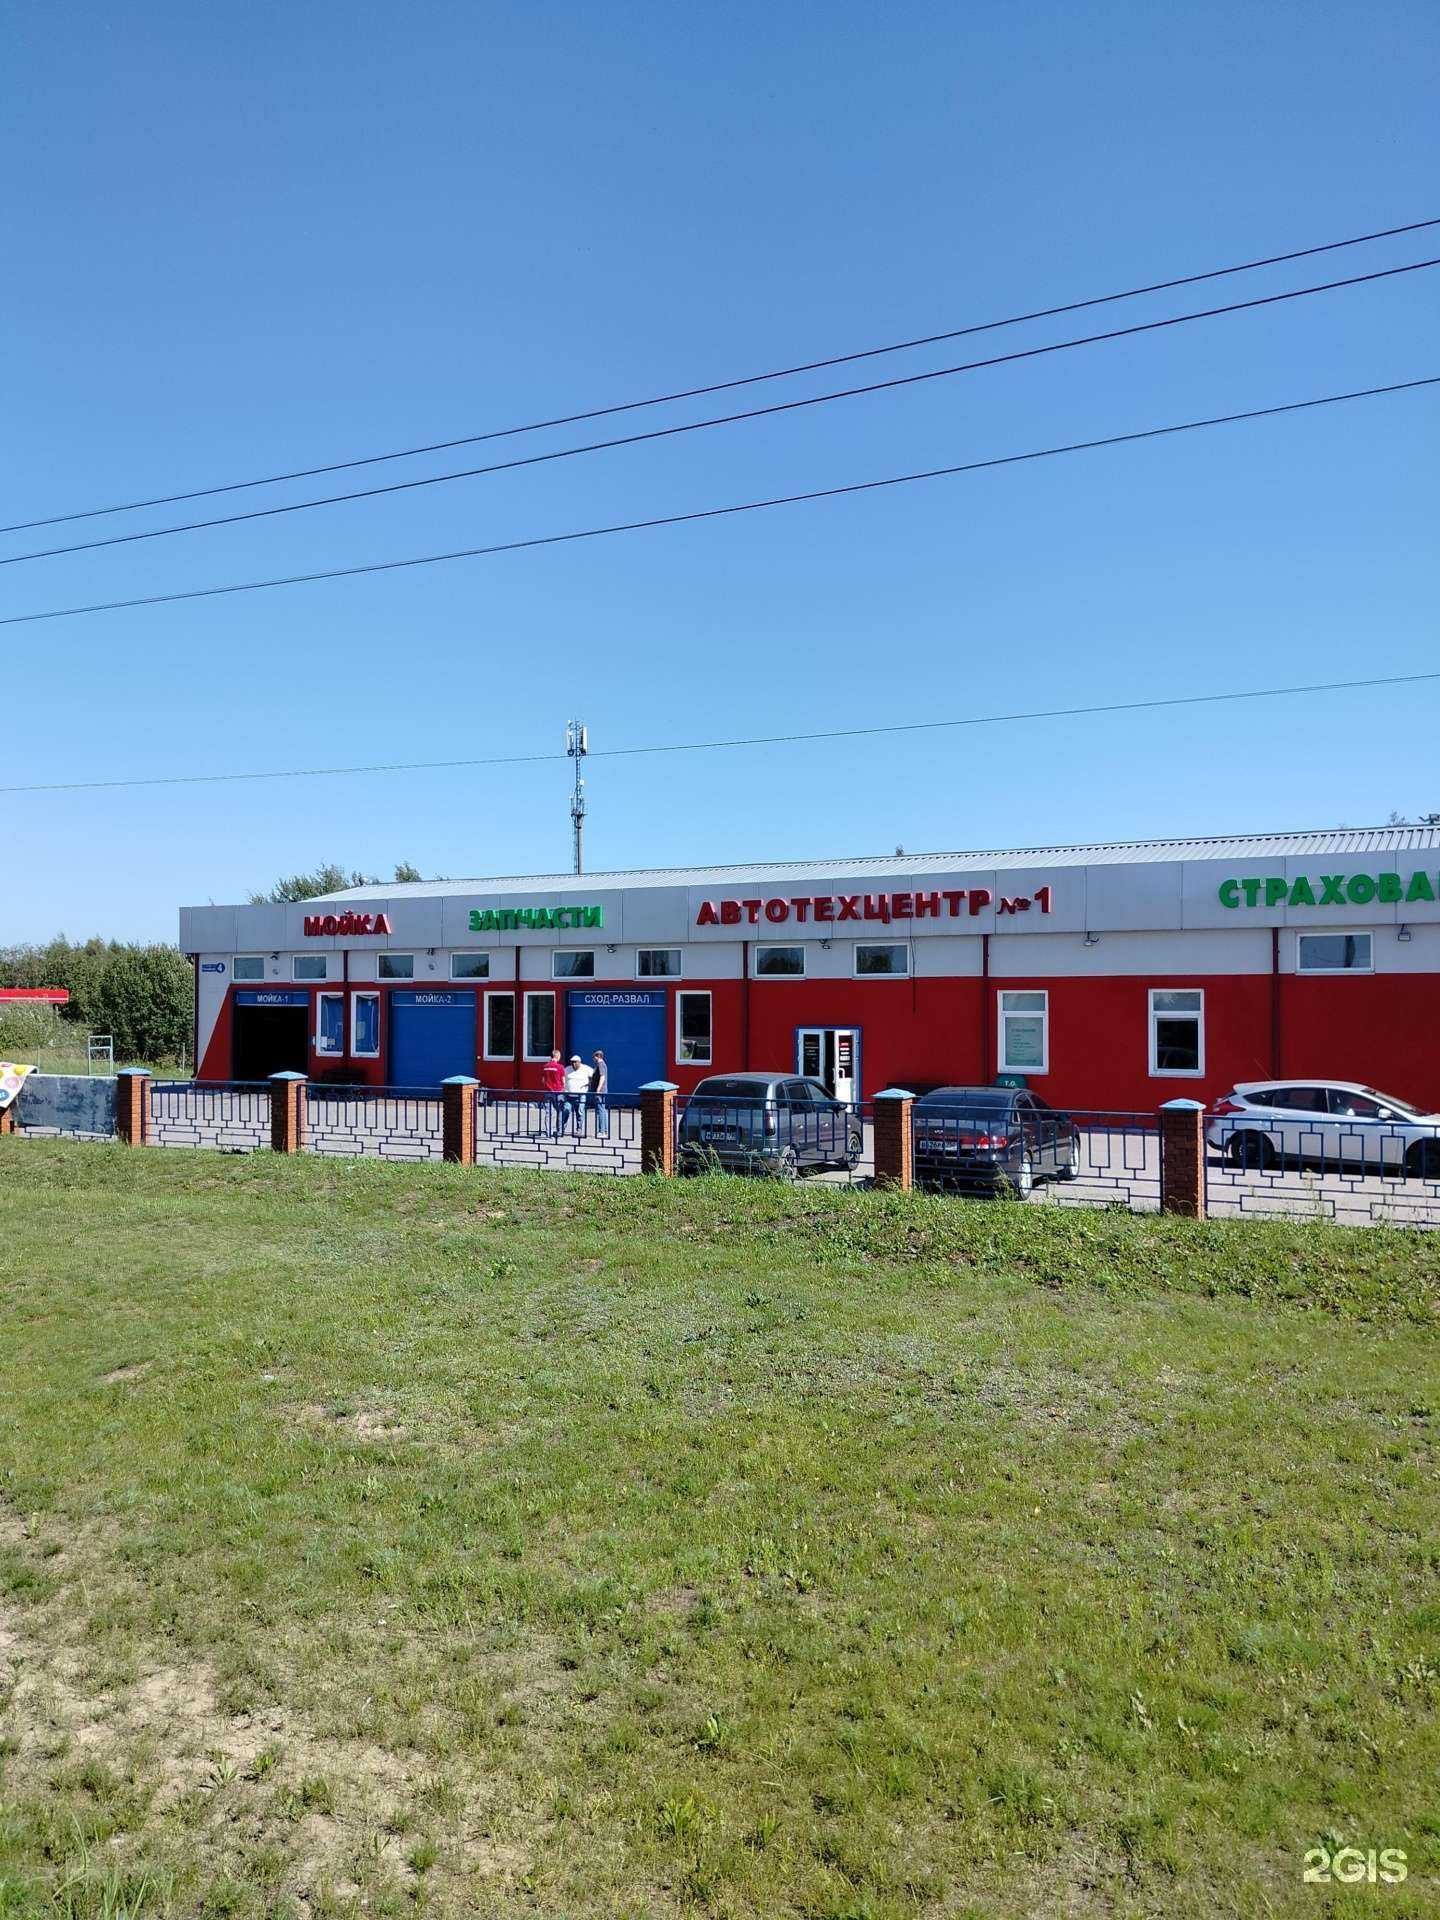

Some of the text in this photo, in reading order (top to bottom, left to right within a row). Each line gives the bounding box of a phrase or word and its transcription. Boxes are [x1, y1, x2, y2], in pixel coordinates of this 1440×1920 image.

[1218, 871, 1440, 909] СТРАХОВА
[469, 906, 603, 931] ЗАПЧАСТИ
[696, 888, 993, 926] АВТОТЕХЦЕНТР
[304, 910, 391, 937] МОЙКА
[256, 993, 289, 1004] МОЙКА-1
[415, 993, 452, 1004] МОЙКА-2
[584, 993, 650, 1005] СХОД-РАЗВАЛ
